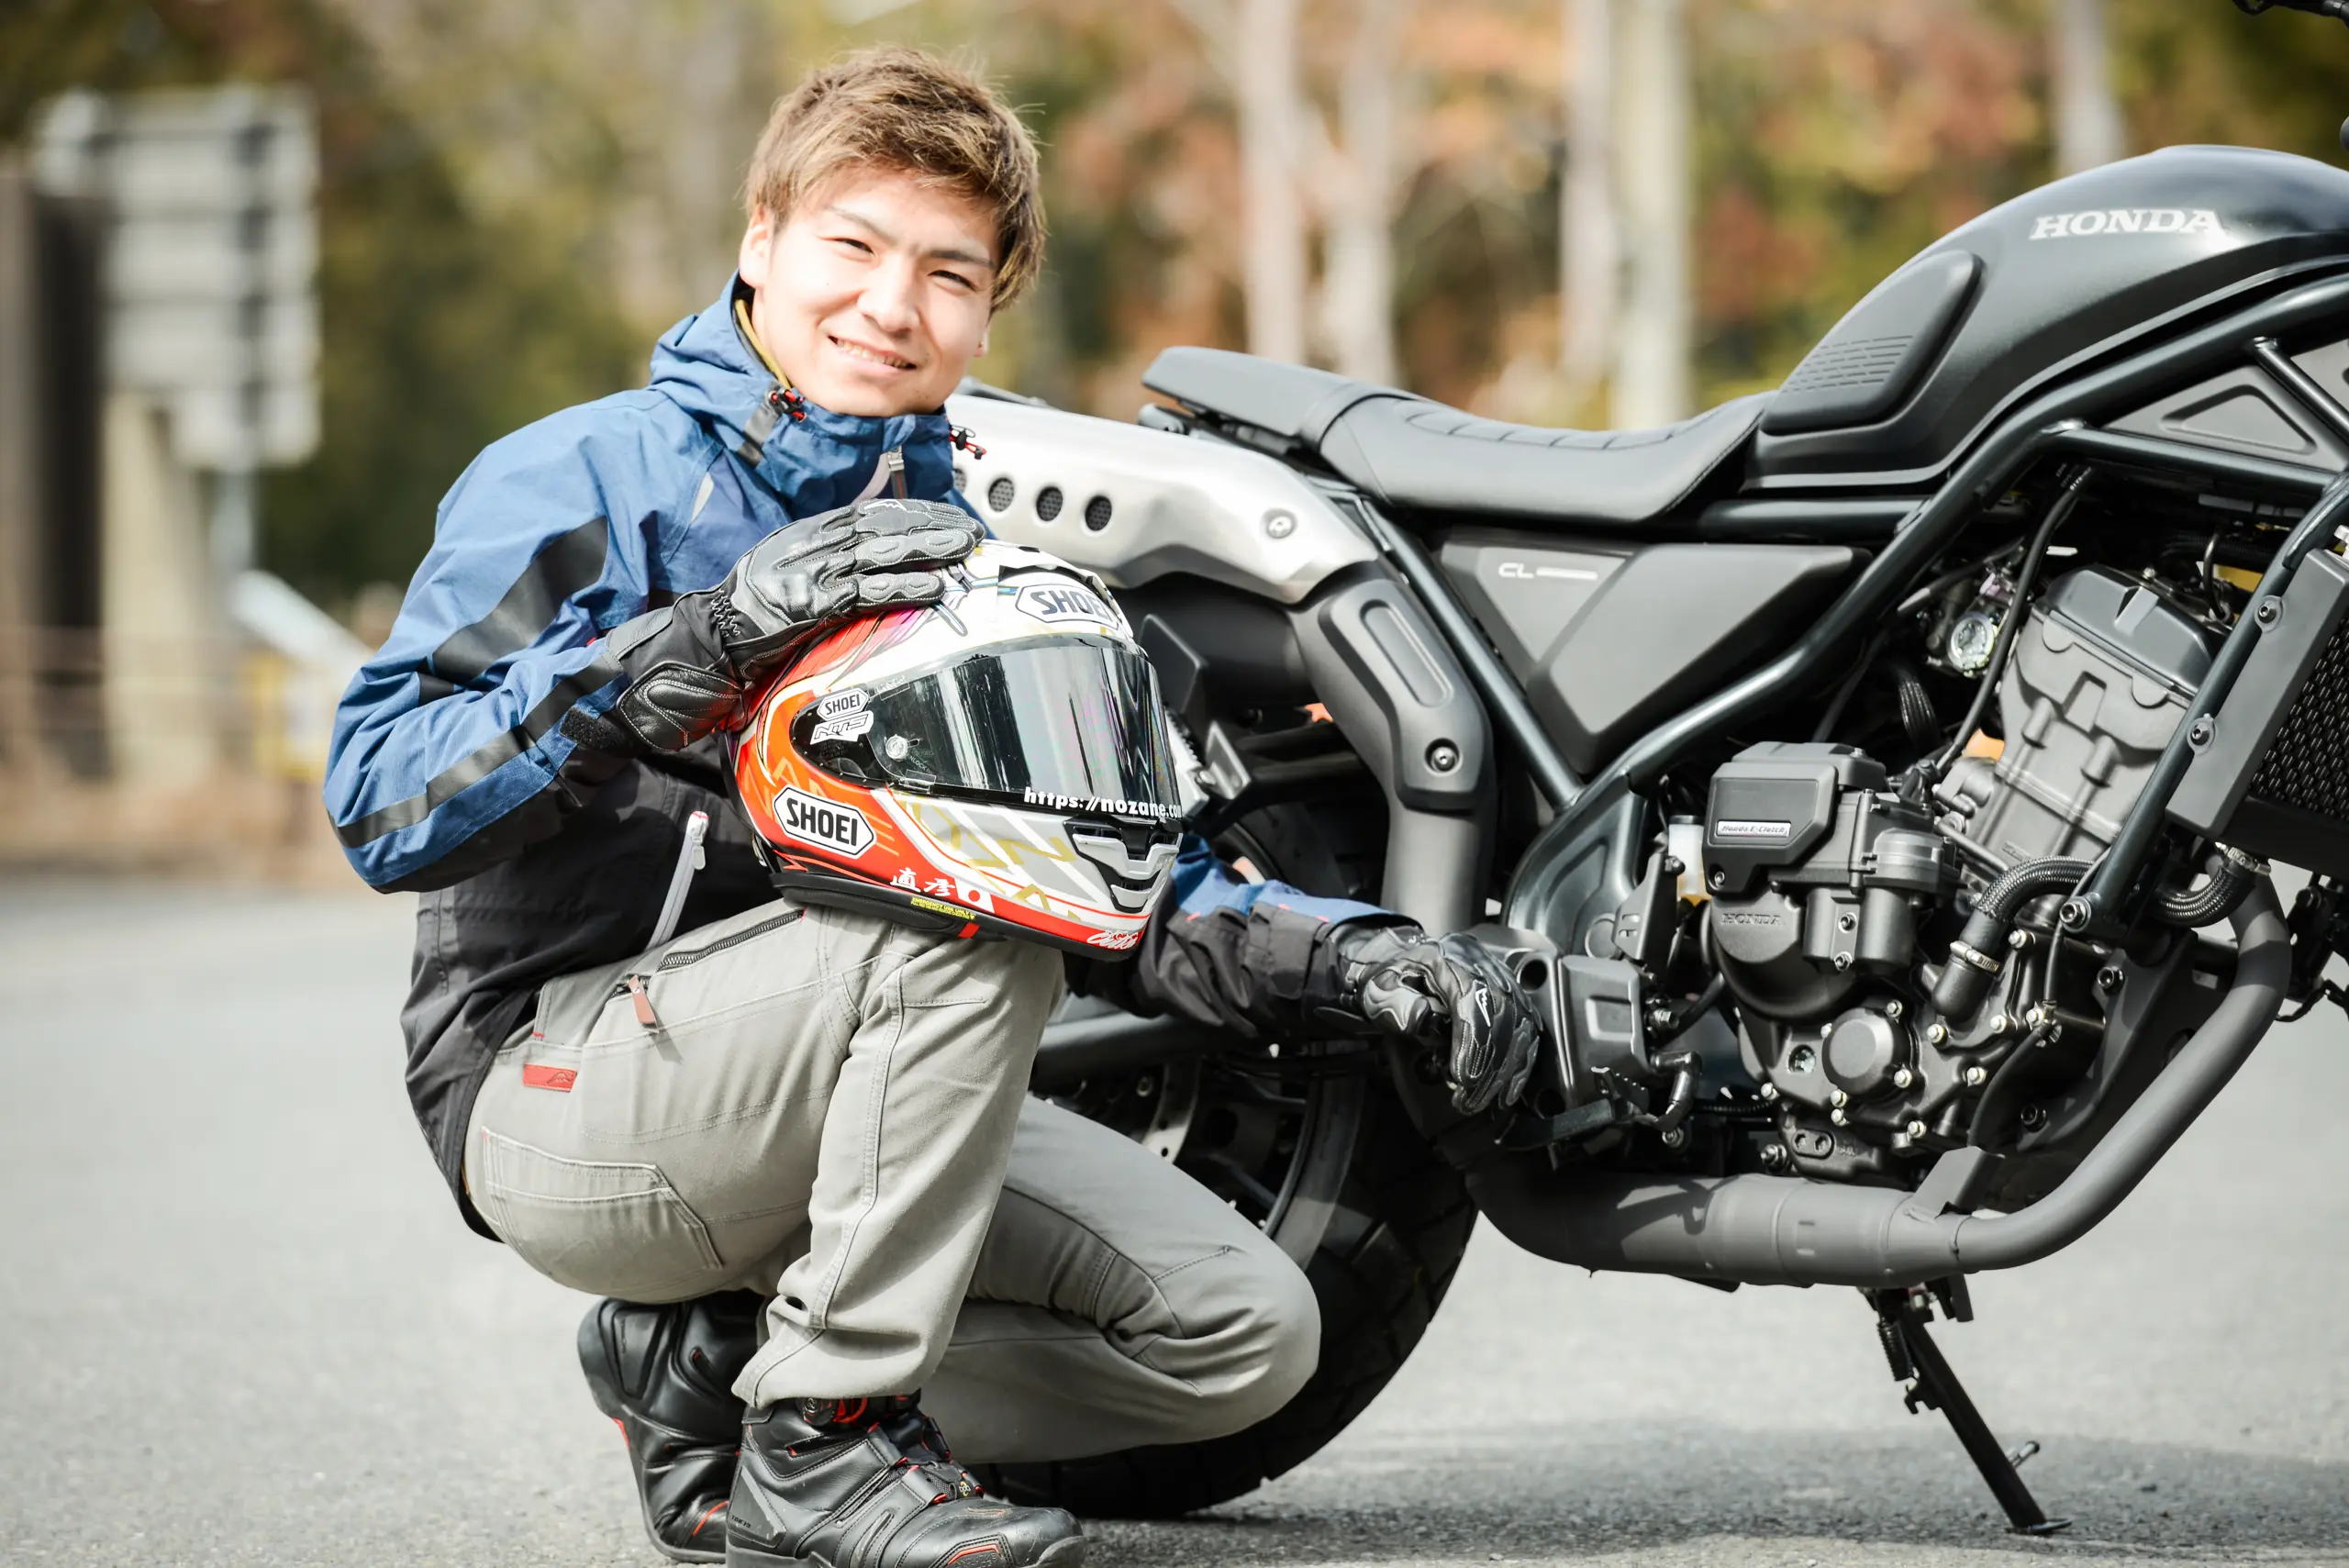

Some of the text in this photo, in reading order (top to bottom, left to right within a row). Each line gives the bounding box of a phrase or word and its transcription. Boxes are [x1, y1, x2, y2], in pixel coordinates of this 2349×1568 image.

[2028, 208, 2226, 240] HONDA
[1498, 562, 1534, 579] CL
[825, 694, 861, 716] SHOEI
[786, 797, 858, 847] SHOEI
[1721, 913, 1783, 926] HONDA
